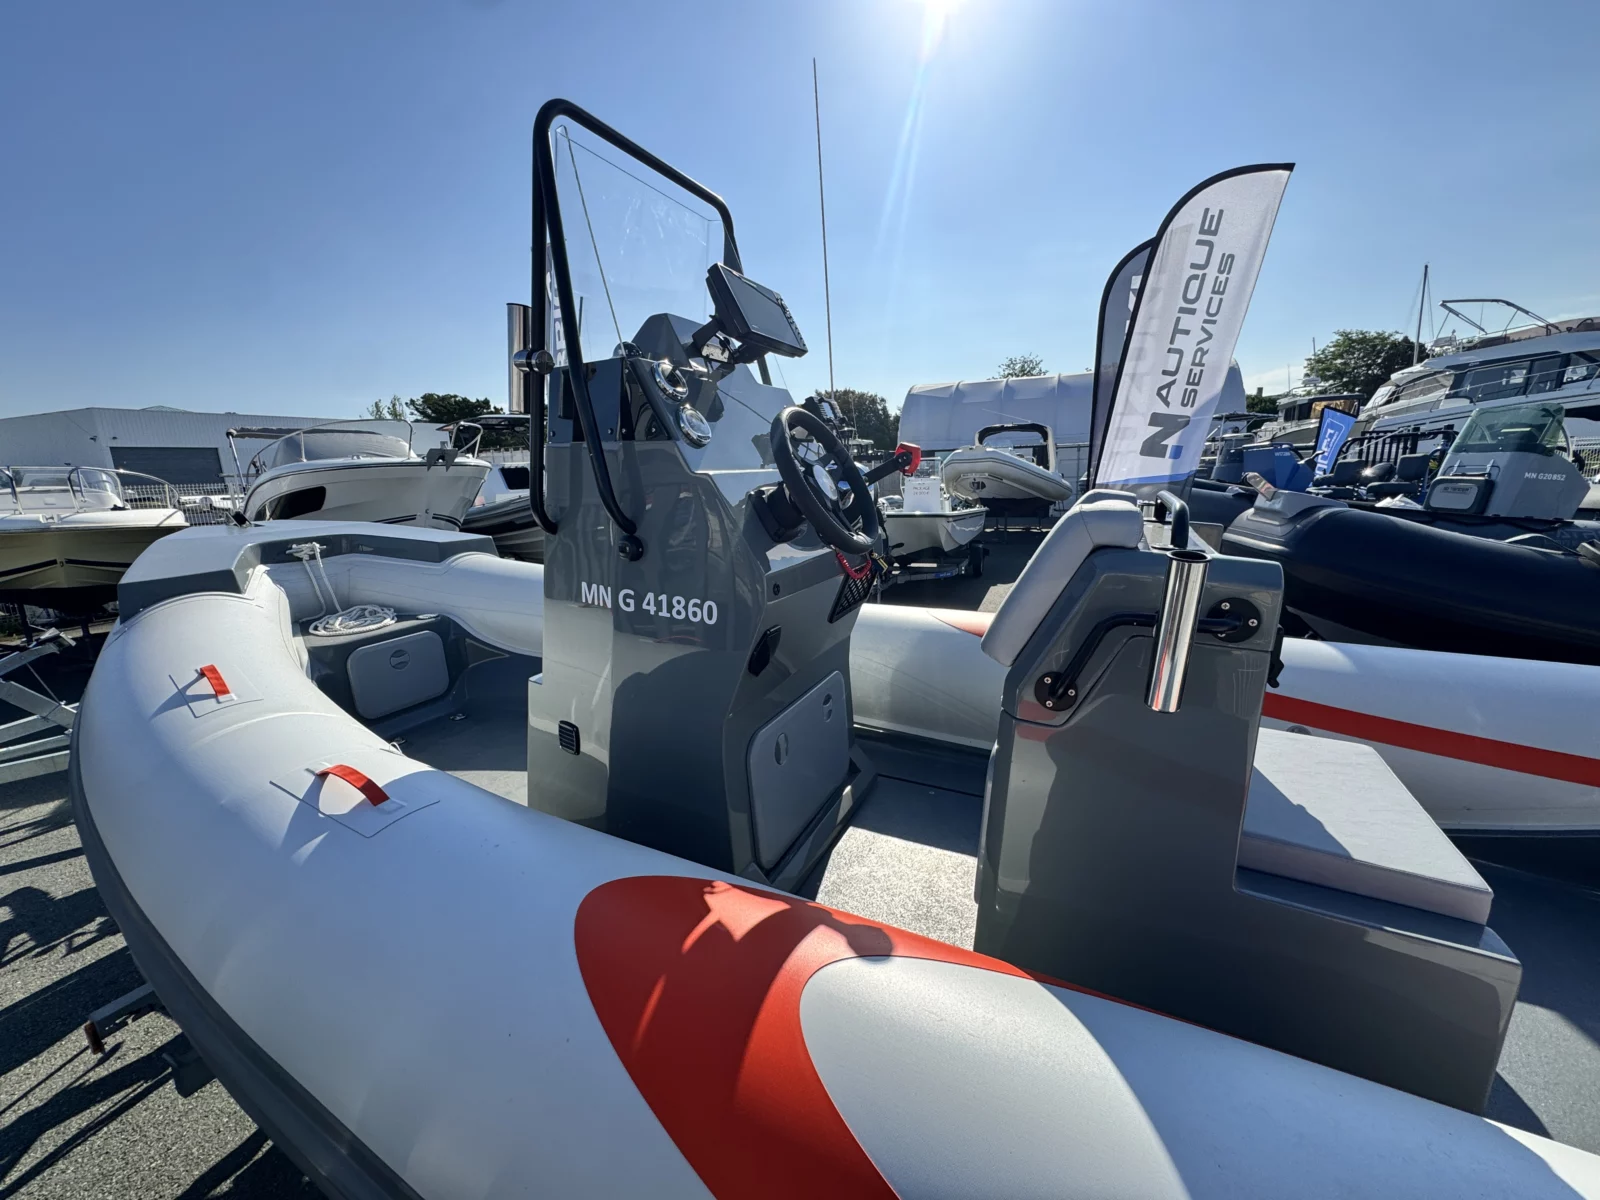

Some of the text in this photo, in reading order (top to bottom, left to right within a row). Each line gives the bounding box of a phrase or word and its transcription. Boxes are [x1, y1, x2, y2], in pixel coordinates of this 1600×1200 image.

[1180, 252, 1236, 408] SERVICES
[581, 581, 718, 625] MN G 41860
